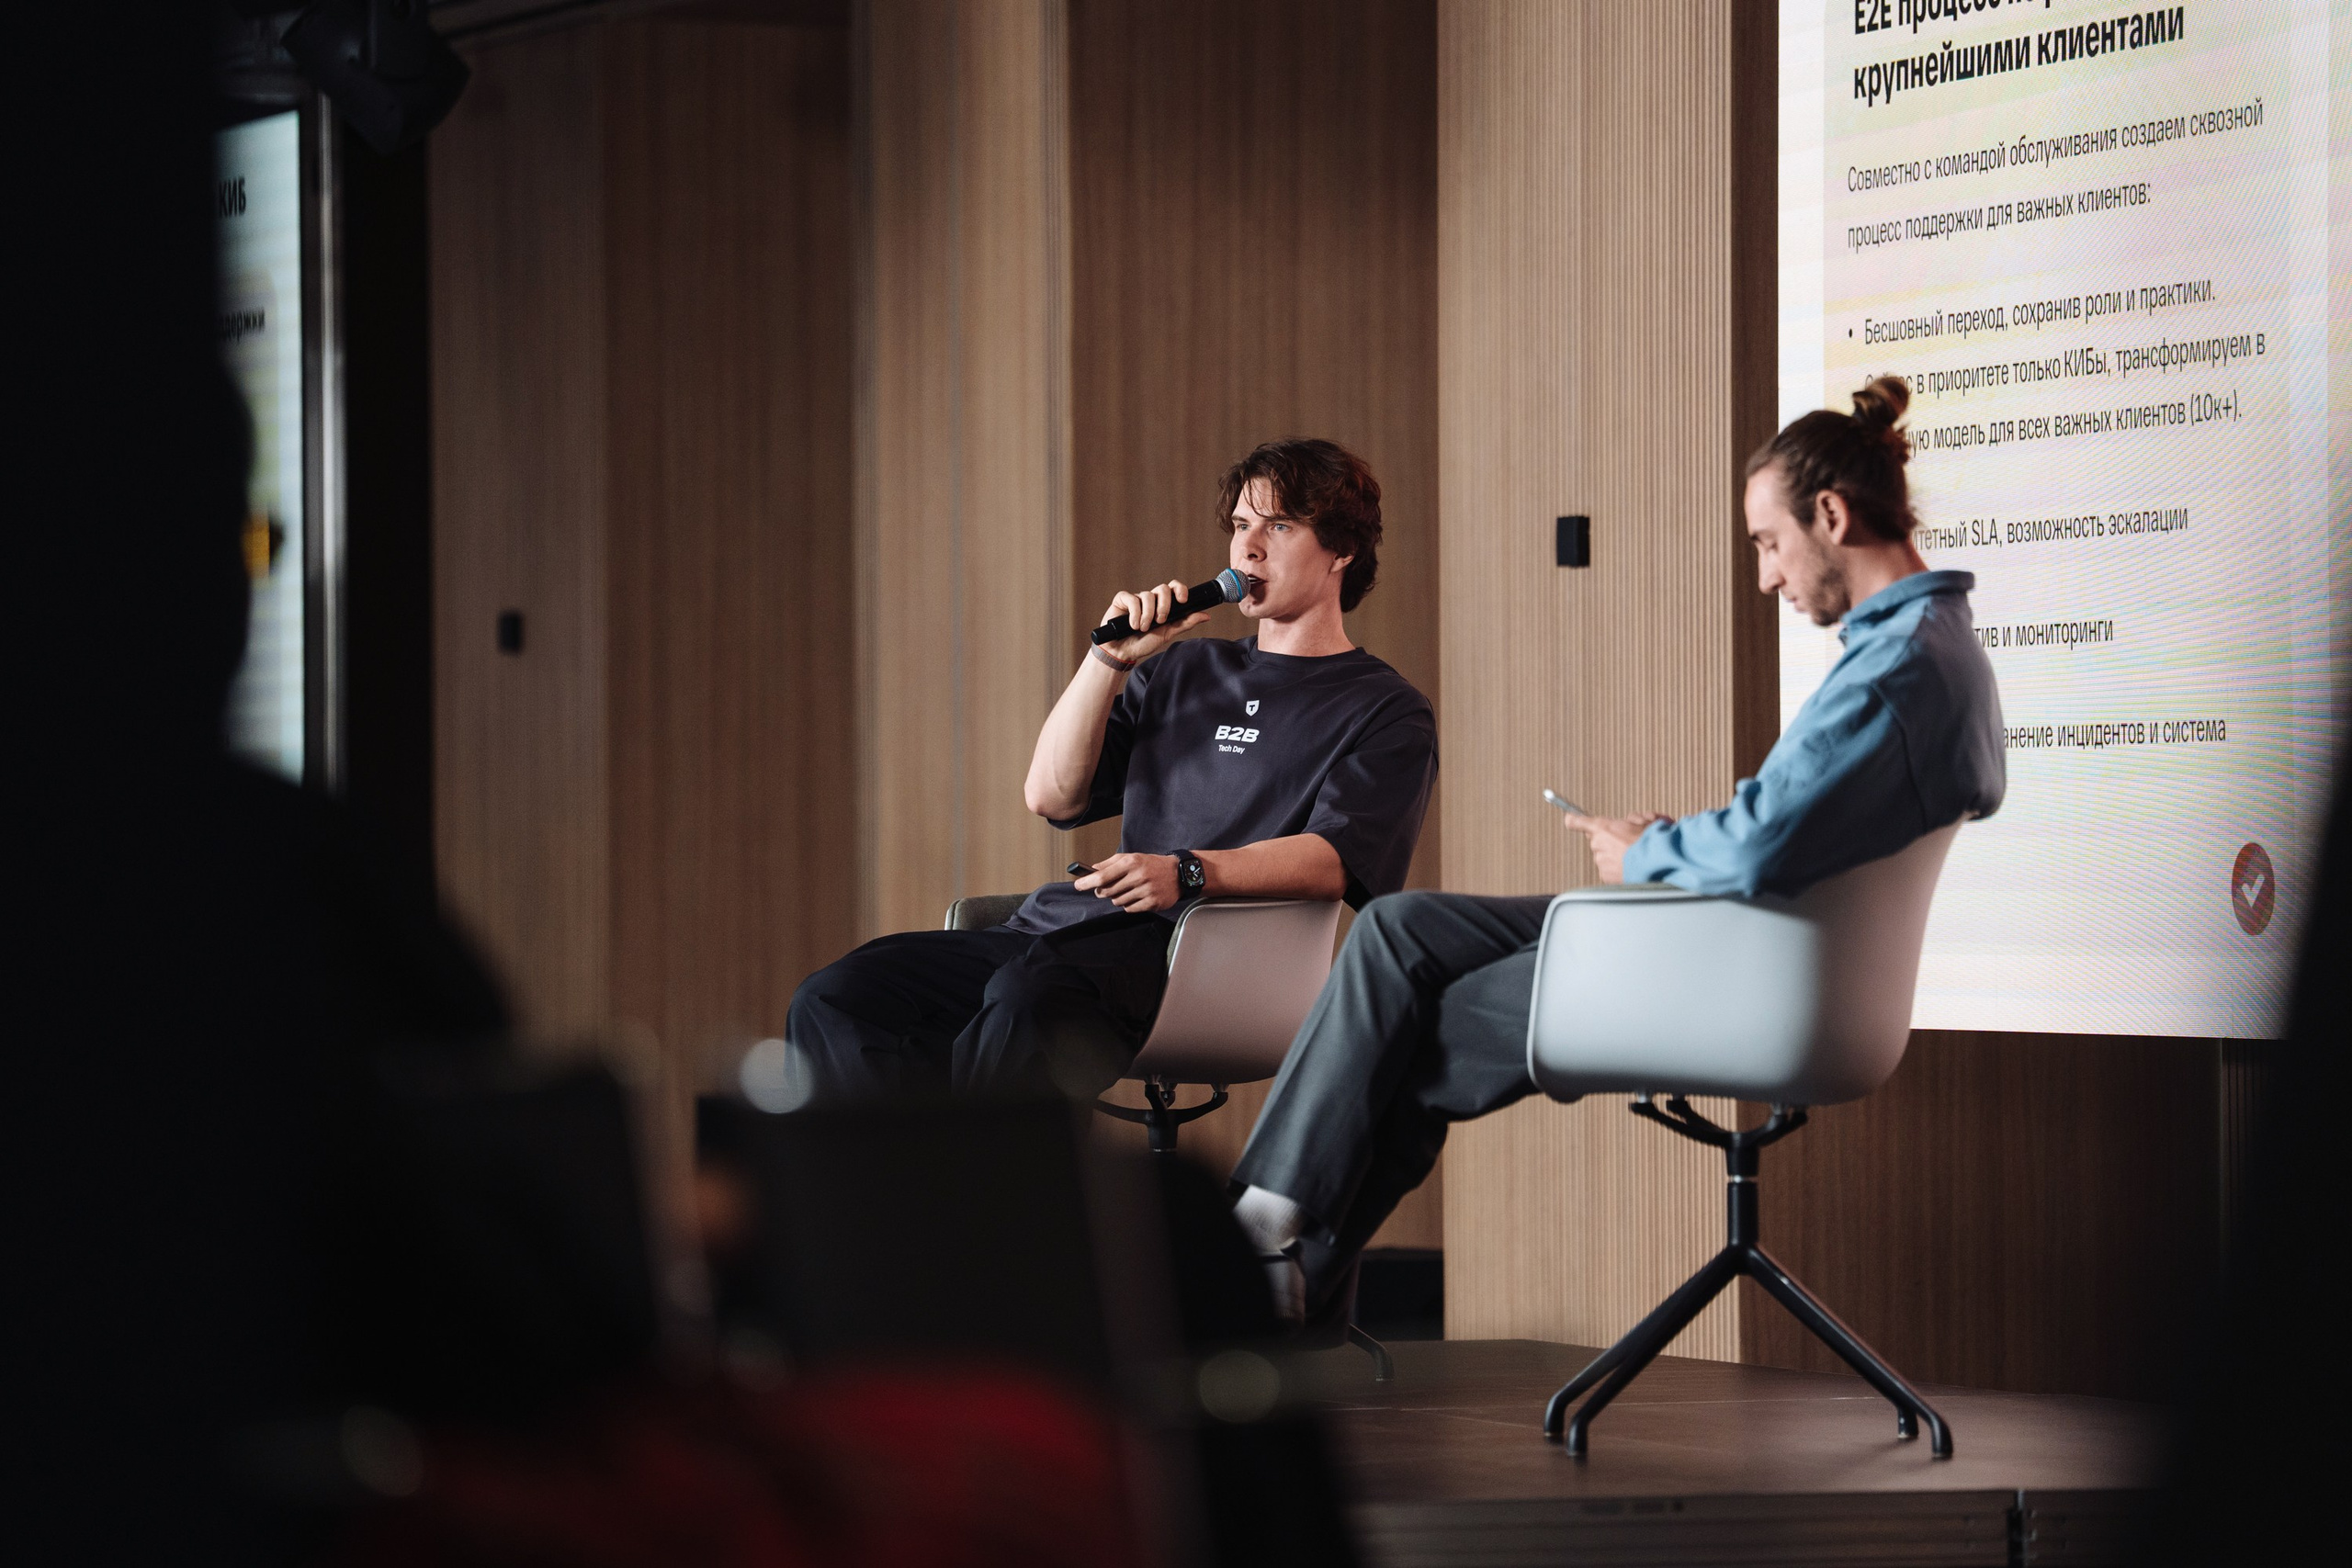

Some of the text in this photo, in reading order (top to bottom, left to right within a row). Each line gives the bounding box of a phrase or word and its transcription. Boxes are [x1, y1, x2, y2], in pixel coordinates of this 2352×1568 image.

[1854, 0, 1998, 35] E2E проц
[1854, 6, 2184, 107] крупнейшими клиентами
[1848, 96, 2264, 192] Совместно с командой обслуживания создаем сквозной
[1848, 182, 2151, 254] процесс поддержки для важных клиентов:
[1864, 279, 2215, 345] Бесшовный переход, сохранив роли и практики.
[1917, 374, 1924, 394] в
[1928, 364, 2008, 400] приоритете
[2013, 357, 2061, 384] только
[2064, 347, 2110, 378] КИБы,
[2115, 334, 2251, 378] трансформируем
[2256, 333, 2266, 355] в
[1933, 423, 1985, 450] модель
[1989, 420, 2014, 446] для
[2018, 414, 2050, 441] всех
[2054, 410, 2111, 438] важных
[2116, 401, 2186, 431] клиентов
[2190, 389, 2242, 426] (10к+).
[1914, 507, 2188, 551] итетный SLA, возможность эскалации
[1974, 619, 2114, 650] тив и мониторинги
[1215, 725, 1260, 743] B2B
[1218, 744, 1246, 755] Tech Day
[2003, 718, 2226, 750] анение инцидентов и система
